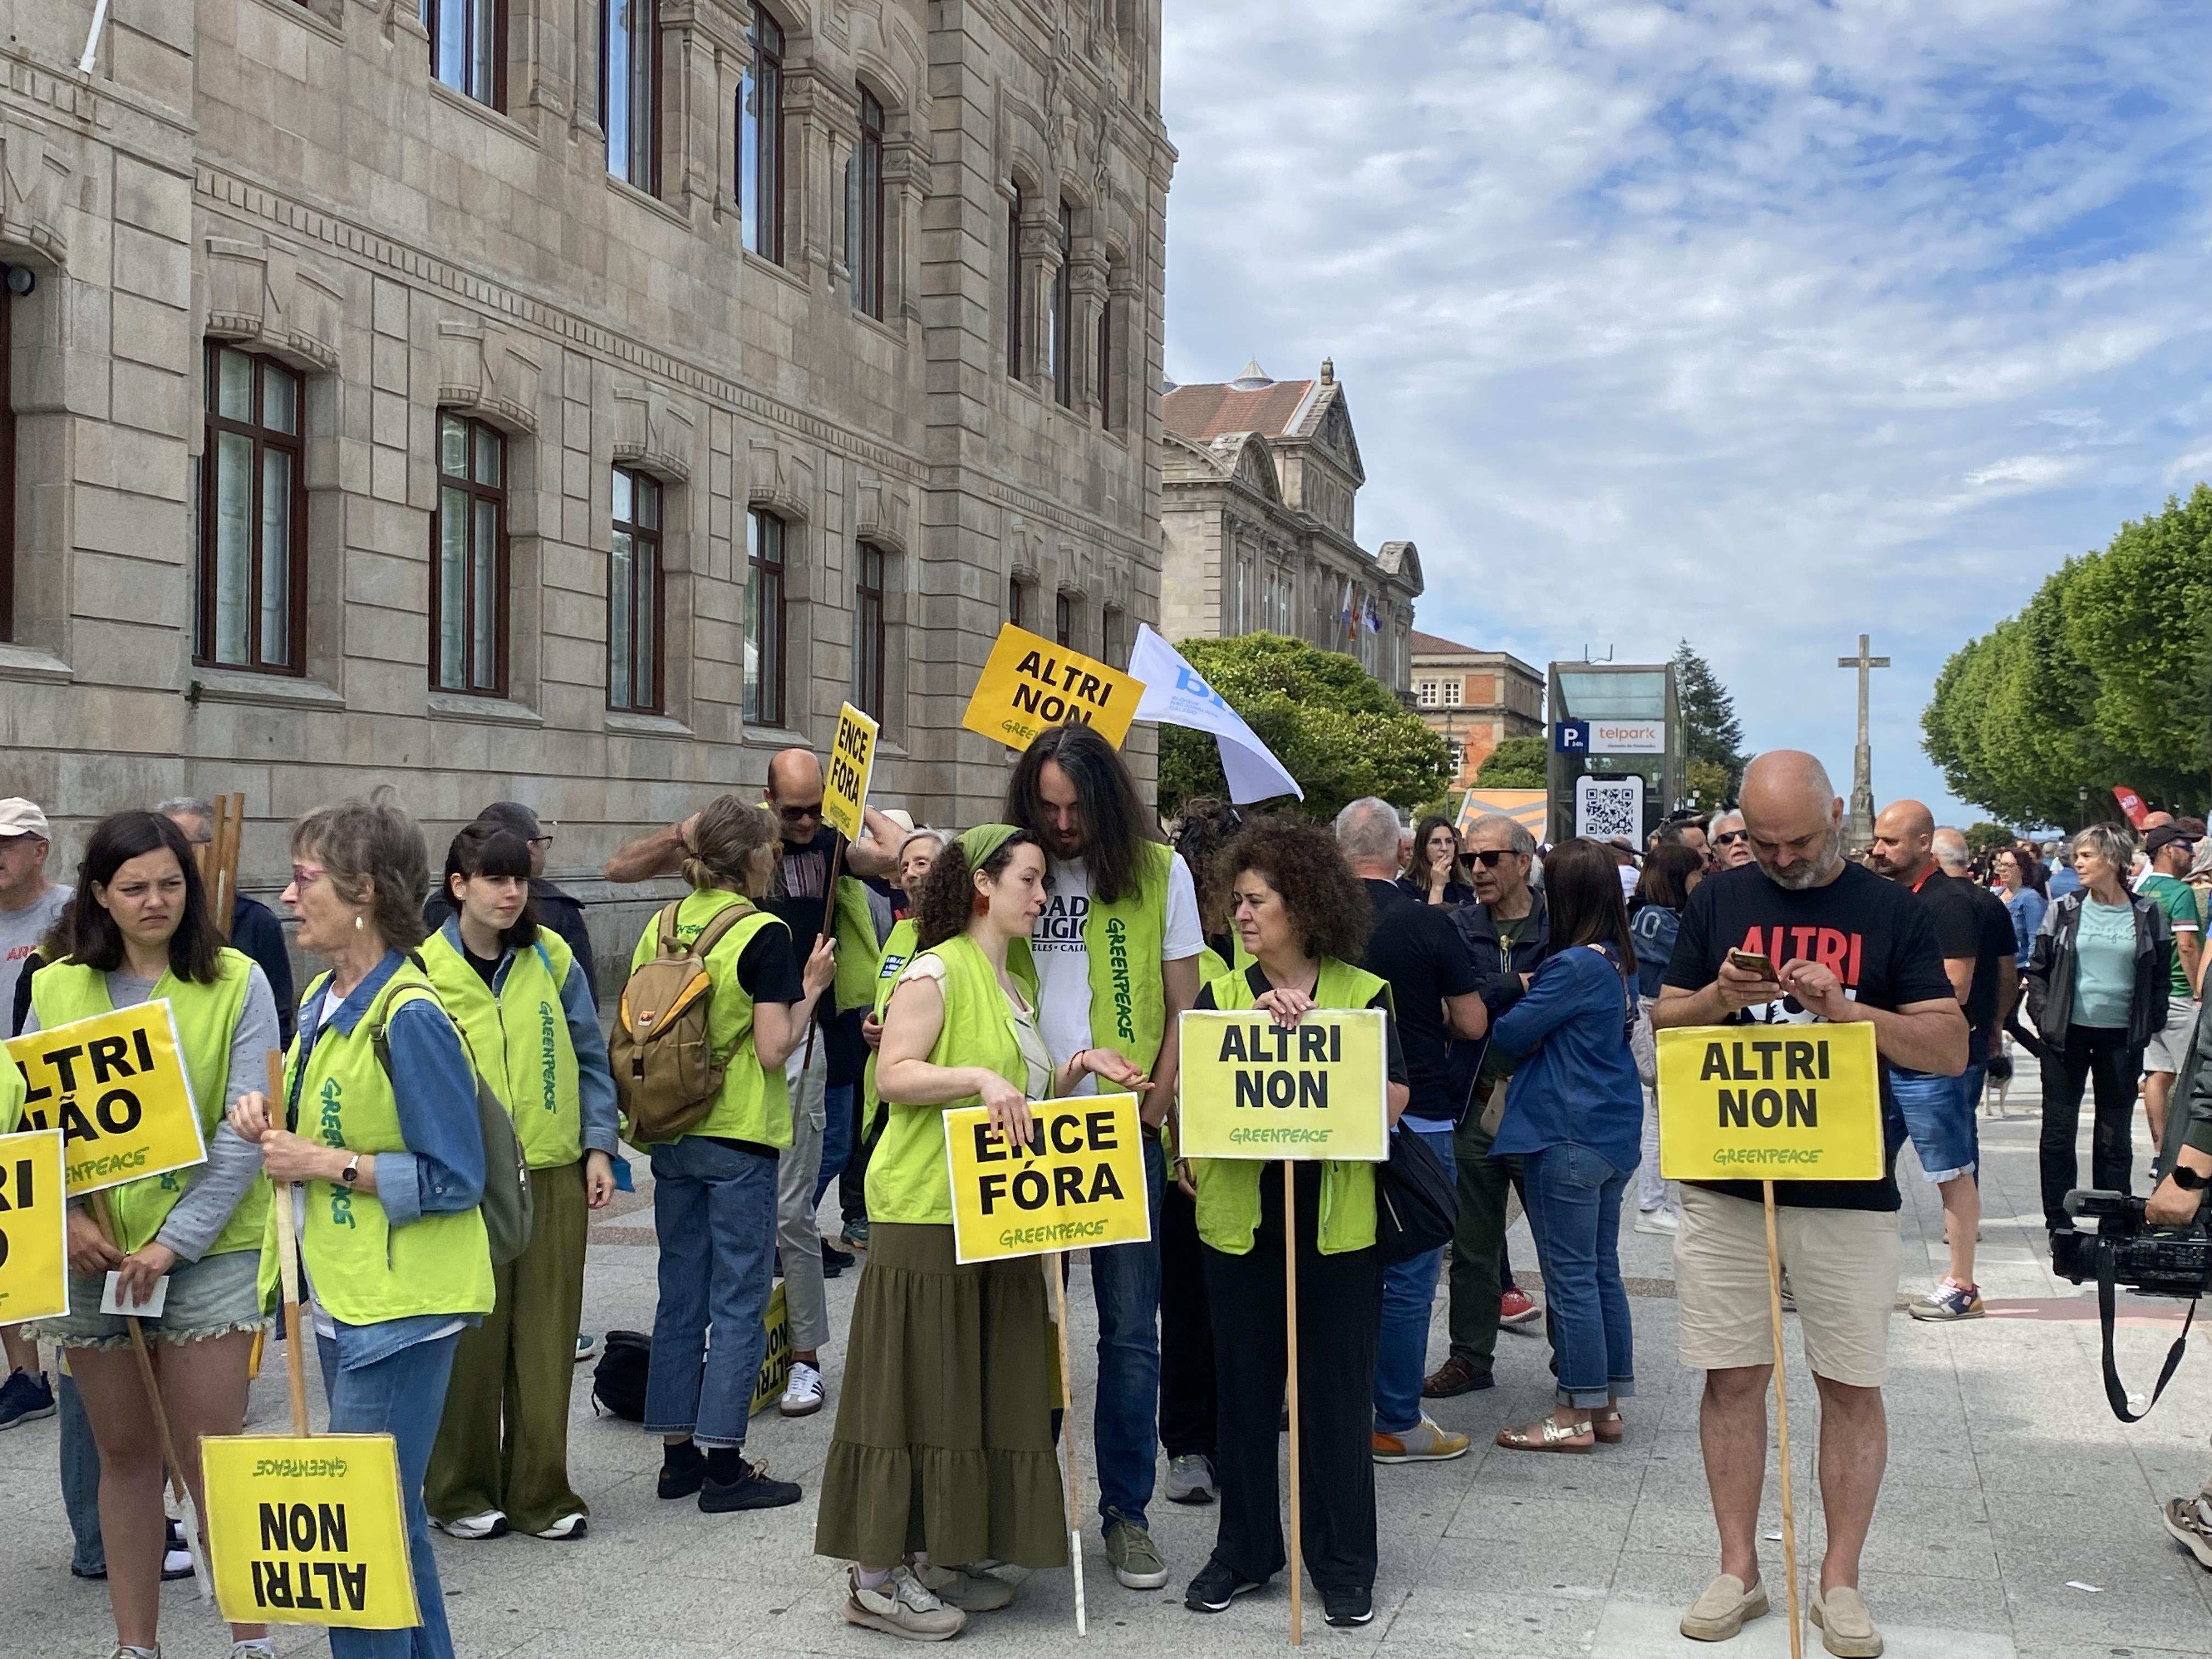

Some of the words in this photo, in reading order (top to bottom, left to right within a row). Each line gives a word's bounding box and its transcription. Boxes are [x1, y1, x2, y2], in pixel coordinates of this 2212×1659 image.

[1015, 651, 1113, 708] ALTRI
[838, 716, 868, 765] ENCE
[1001, 719, 1037, 740] GREE
[1564, 728, 1578, 747] P
[1599, 727, 1656, 741] telpark
[831, 755, 860, 807] FÓRA
[1105, 918, 1136, 1043] GREENPEACE
[539, 1001, 556, 1114] GREENPEACE
[1218, 1024, 1341, 1062] ALTRI
[1700, 1040, 1830, 1080] ALTRI
[15, 1028, 155, 1104] LTRI
[1235, 1070, 1328, 1108] NON
[1718, 1088, 1818, 1128] NON
[974, 1111, 1118, 1163] ENCE
[1229, 1127, 1333, 1145] GREENPEACE
[1713, 1148, 1824, 1166] GREENPEACE
[979, 1160, 1125, 1215] FÓRA
[999, 1218, 1109, 1248] GREENPEACE
[252, 1456, 348, 1477] GREENPEACE
[259, 1503, 348, 1553] NON
[251, 1561, 367, 1611] ALTRI
